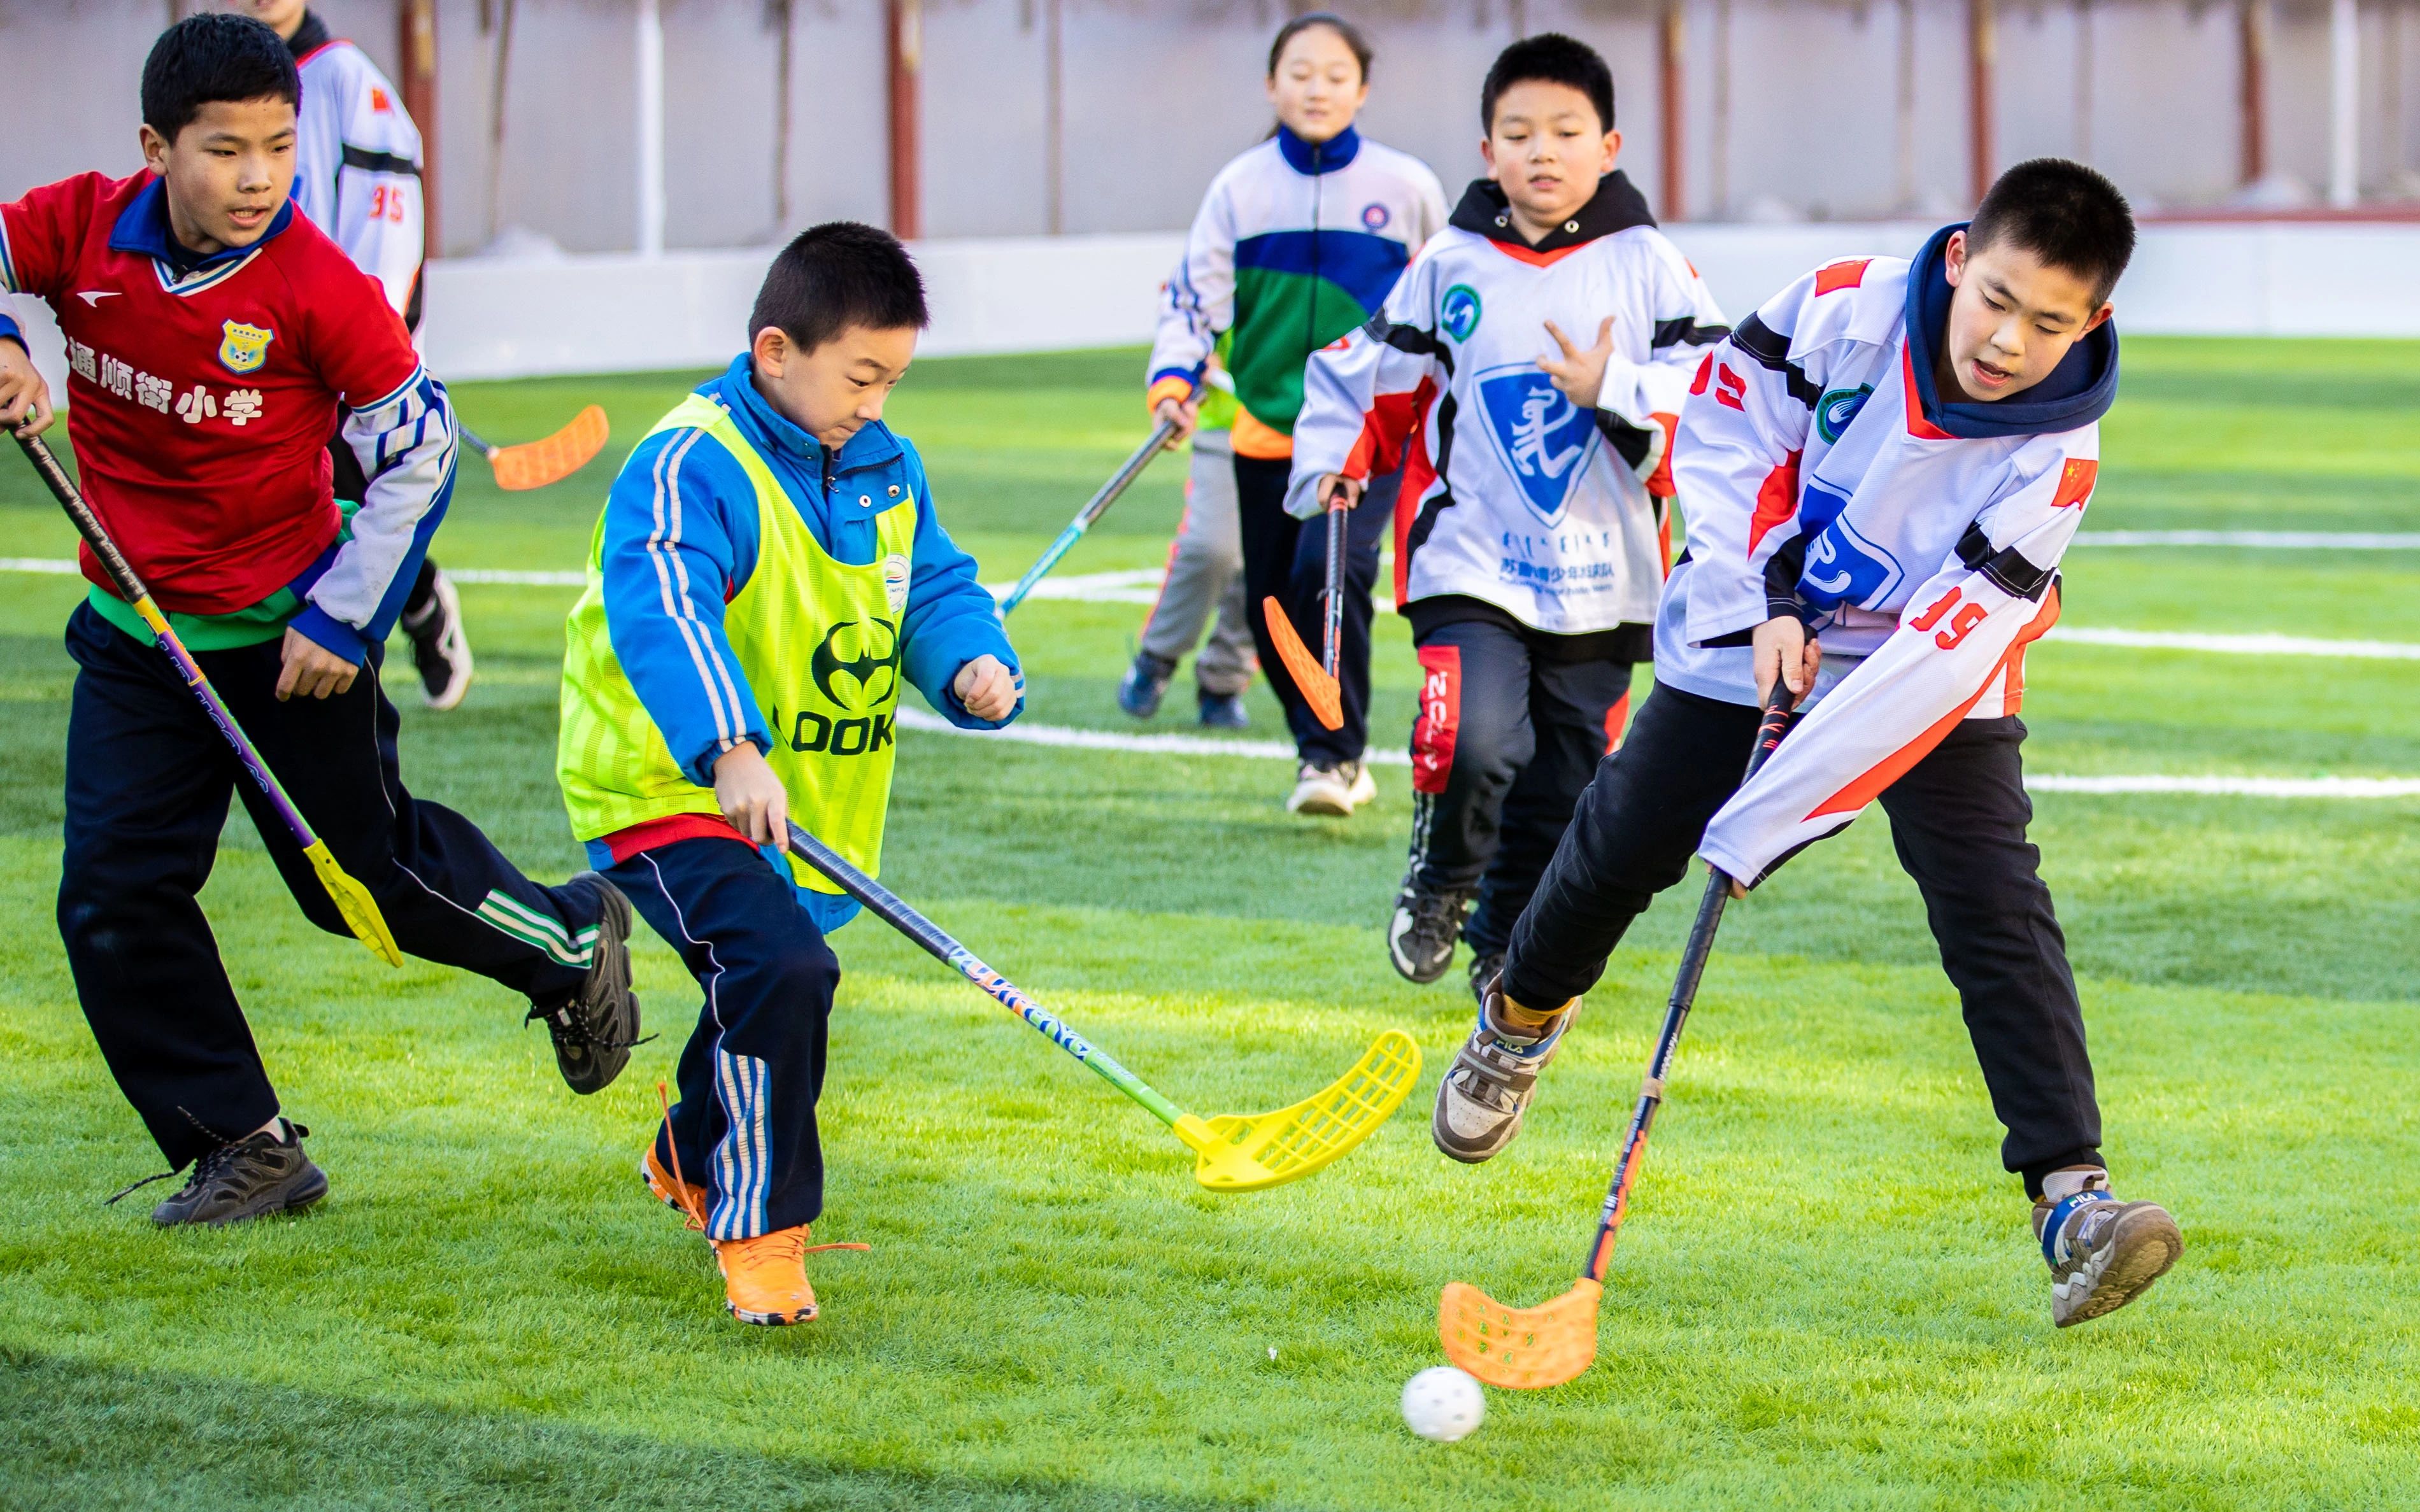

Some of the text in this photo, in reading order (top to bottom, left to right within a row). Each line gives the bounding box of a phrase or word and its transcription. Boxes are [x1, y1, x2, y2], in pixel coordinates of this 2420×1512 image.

[69, 336, 263, 426] 通顺街小学
[1496, 1038, 1524, 1054] FILA
[2068, 1192, 2099, 1208] FILA
